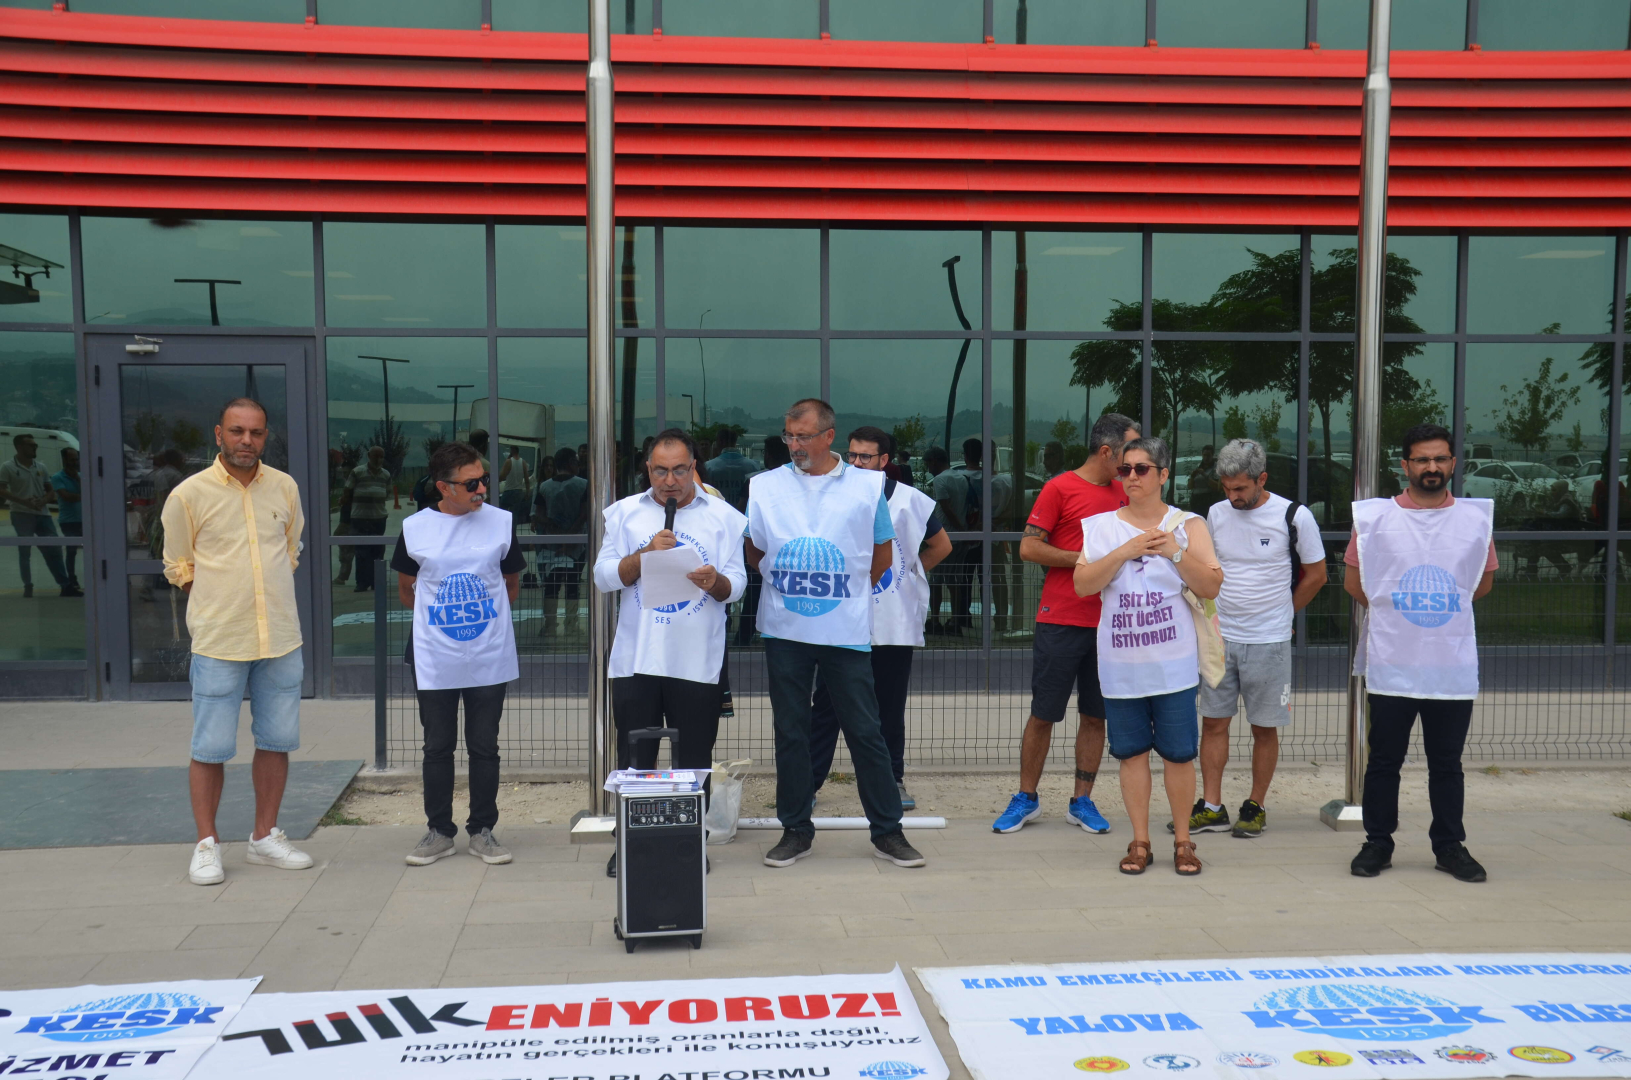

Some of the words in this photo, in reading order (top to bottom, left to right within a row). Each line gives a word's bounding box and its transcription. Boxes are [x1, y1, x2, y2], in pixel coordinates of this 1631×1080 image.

[770, 570, 851, 599] KESK
[427, 598, 498, 626] KESK
[796, 600, 821, 614] 1995
[1119, 591, 1144, 610] EŞİT
[1391, 591, 1462, 612] KESK
[655, 616, 671, 624] SES
[1112, 610, 1134, 631] EŞİT
[1136, 605, 1174, 628] ÜCRET
[1418, 615, 1440, 625] 1995
[456, 627, 477, 638] 1995
[1111, 625, 1177, 648] İSTİYORUZ!
[960, 976, 1048, 989] KAMU
[1055, 967, 1244, 987] EMEKÇİLERİ
[1249, 965, 1453, 981] SENDİKALARI
[14, 1007, 224, 1034] KESK
[1009, 1012, 1203, 1035] YALOVA
[1241, 1005, 1506, 1028] KESK
[405, 1038, 543, 1051] manipüle
[554, 1035, 660, 1046] edilmiş
[671, 1030, 800, 1042] oranlarla
[810, 1026, 889, 1037] değil,
[1354, 1027, 1429, 1039] 1995
[400, 1050, 512, 1064] hayatın
[523, 1044, 672, 1061] gerçekleri
[684, 1044, 717, 1052] ile
[728, 1035, 922, 1051] konuşuyoruz
[858, 1067, 929, 1077] KESK
